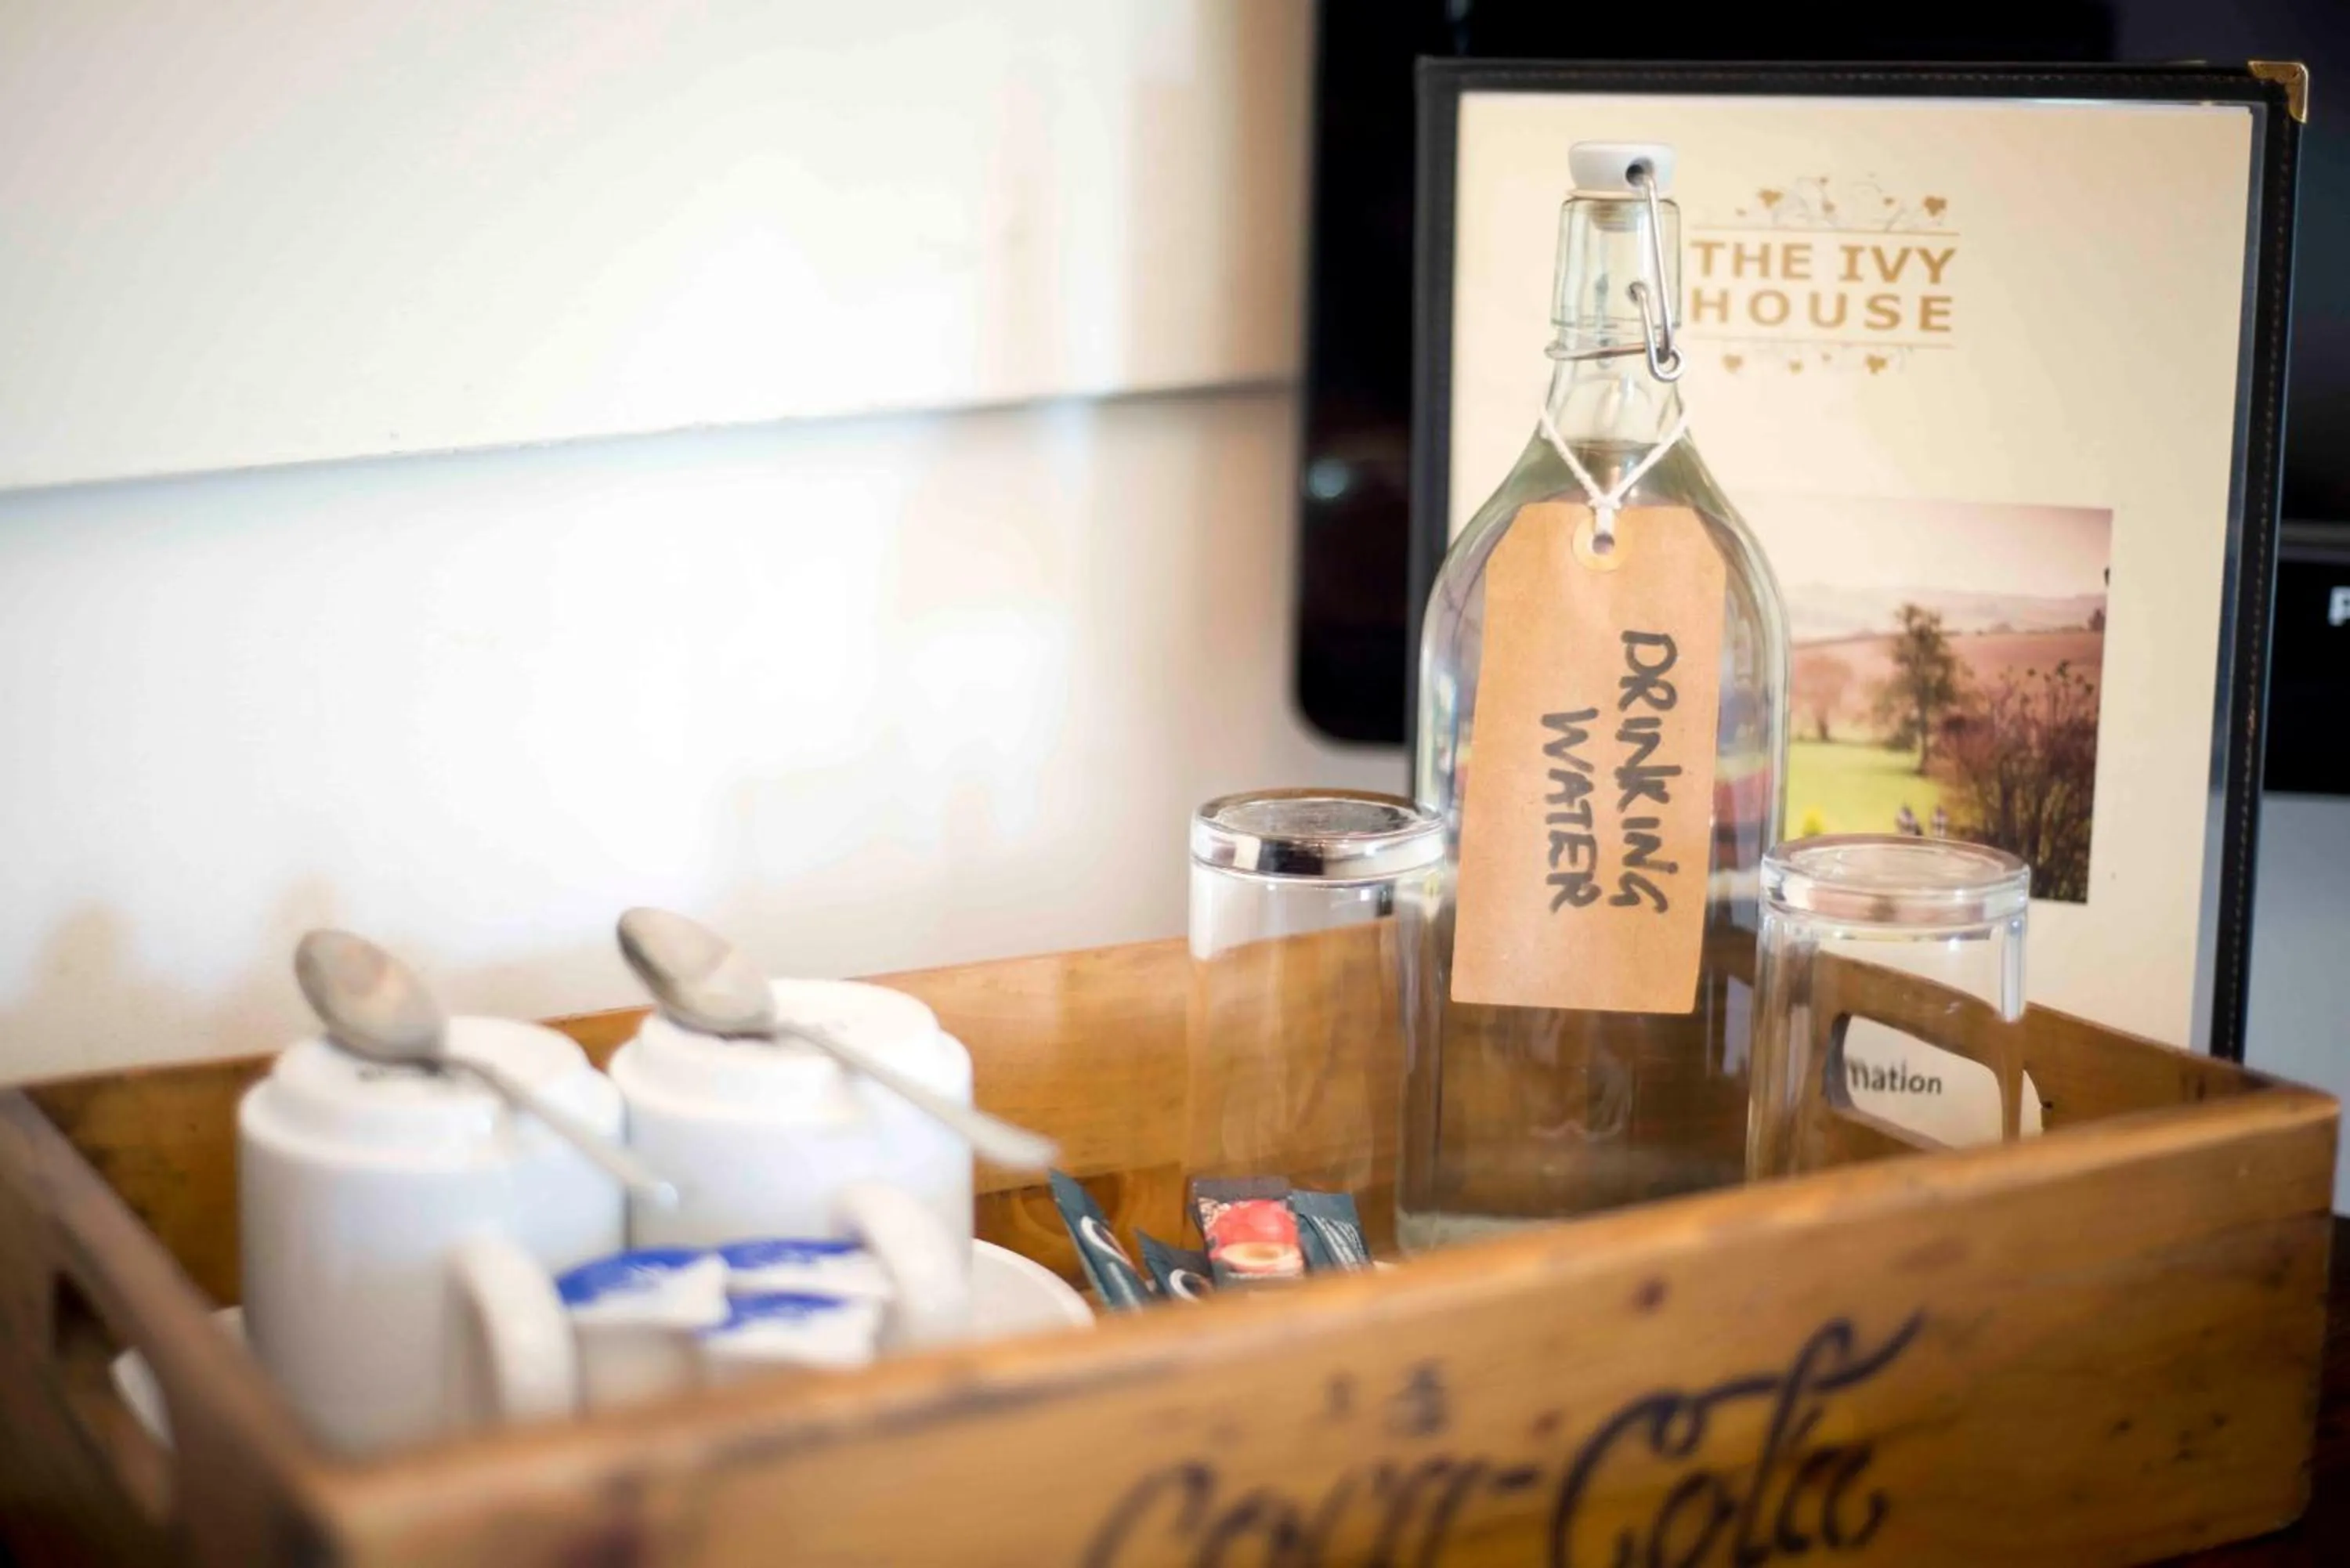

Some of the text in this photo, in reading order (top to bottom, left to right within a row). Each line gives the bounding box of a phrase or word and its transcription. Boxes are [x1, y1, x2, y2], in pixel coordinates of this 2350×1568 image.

[1690, 240, 1957, 285] THE IVY
[1690, 287, 1953, 332] HOUSE
[1540, 706, 1603, 915] WATER
[1608, 629, 1683, 913] DRINKING
